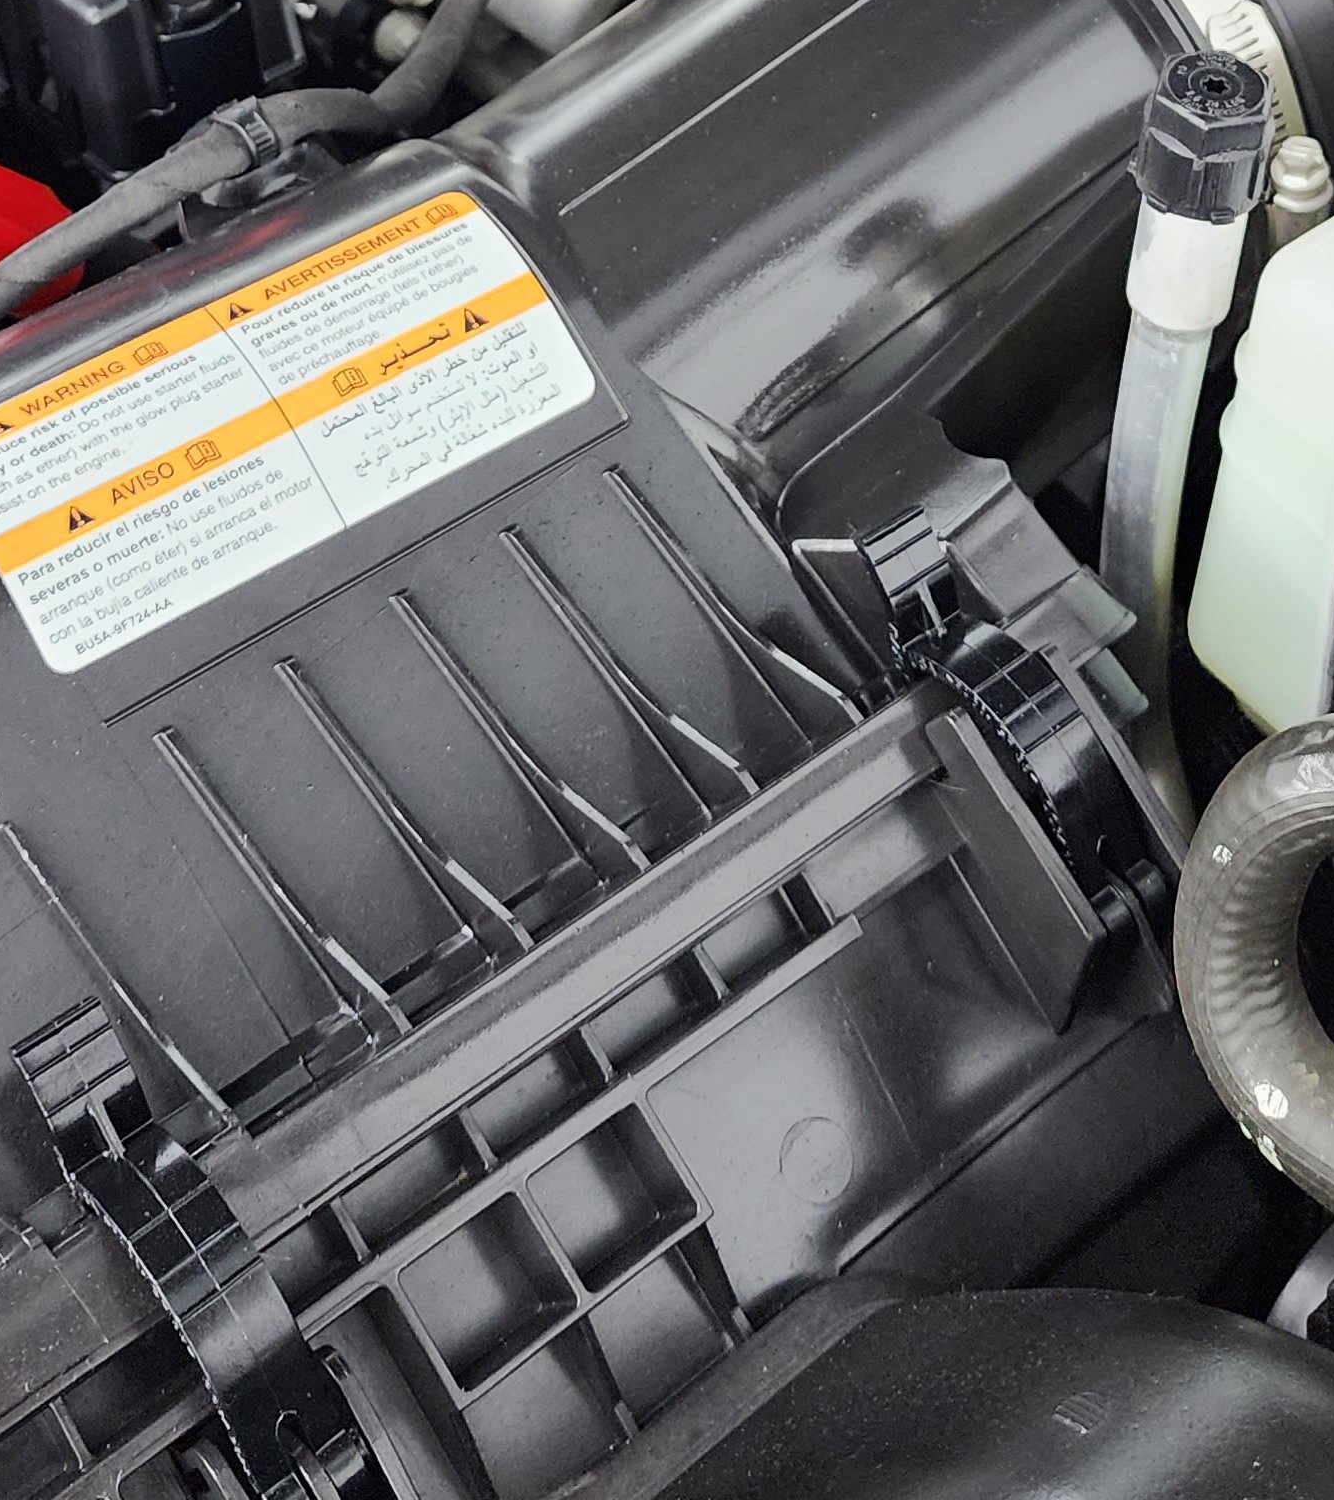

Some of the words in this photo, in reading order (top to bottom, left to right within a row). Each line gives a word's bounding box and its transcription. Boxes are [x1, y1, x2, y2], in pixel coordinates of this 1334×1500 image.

[239, 313, 274, 335] Pour
[325, 283, 341, 293] le
[342, 261, 385, 286] risque
[385, 252, 404, 264] de
[404, 222, 468, 255] blessures
[249, 320, 298, 348] graves
[298, 308, 319, 322] ou
[319, 299, 338, 312] de
[430, 243, 456, 261] pas
[455, 234, 473, 246] de
[264, 217, 420, 300] AVERTISSEMENT
[257, 332, 303, 359] fluides
[303, 323, 322, 337] de
[267, 350, 301, 372] avec
[301, 342, 319, 355] ce
[319, 318, 365, 346] moteur
[410, 288, 429, 301] de
[427, 264, 479, 293] bougies
[470, 345, 489, 362] من
[18, 360, 125, 415] WARNING
[29, 420, 60, 438] risk
[60, 408, 77, 423] of
[79, 380, 141, 416] possible
[143, 354, 197, 383] serious
[277, 371, 296, 385] de
[443, 353, 468, 378] خطر
[8, 453, 25, 467] or
[30, 429, 76, 457] death:
[76, 417, 100, 434] Do
[101, 404, 126, 421] not
[126, 393, 153, 410] use
[153, 370, 197, 397] starter
[197, 353, 236, 375] fluids
[14, 469, 34, 485] as
[35, 447, 78, 474] ether)
[78, 432, 109, 452] with
[108, 421, 133, 437] the
[134, 405, 167, 428] glow
[168, 389, 201, 412] plug
[200, 366, 243, 393] starter
[321, 403, 367, 438] المحتمل
[16, 561, 55, 586] Para
[57, 531, 111, 566] reducir
[114, 520, 130, 537] el
[131, 499, 179, 528] riesgo
[181, 487, 202, 504] de
[201, 455, 264, 492] lesiones
[25, 483, 47, 499] on
[46, 471, 72, 489] the
[111, 461, 175, 505] AVISO
[28, 567, 90, 605] severas
[91, 560, 104, 573] o
[105, 529, 164, 566] muerte:
[164, 518, 188, 534] No
[189, 503, 217, 523] use
[216, 479, 264, 508] fluidos
[264, 468, 284, 485] de
[38, 584, 104, 625] arranque
[105, 559, 152, 591] (como
[153, 541, 188, 565] éter)
[188, 534, 203, 548] si
[204, 506, 257, 540] arranca
[258, 495, 273, 511] el
[273, 475, 312, 504] motor
[48, 623, 77, 644] con
[76, 614, 94, 629] la
[133, 565, 189, 600] caliente
[190, 554, 210, 571] de
